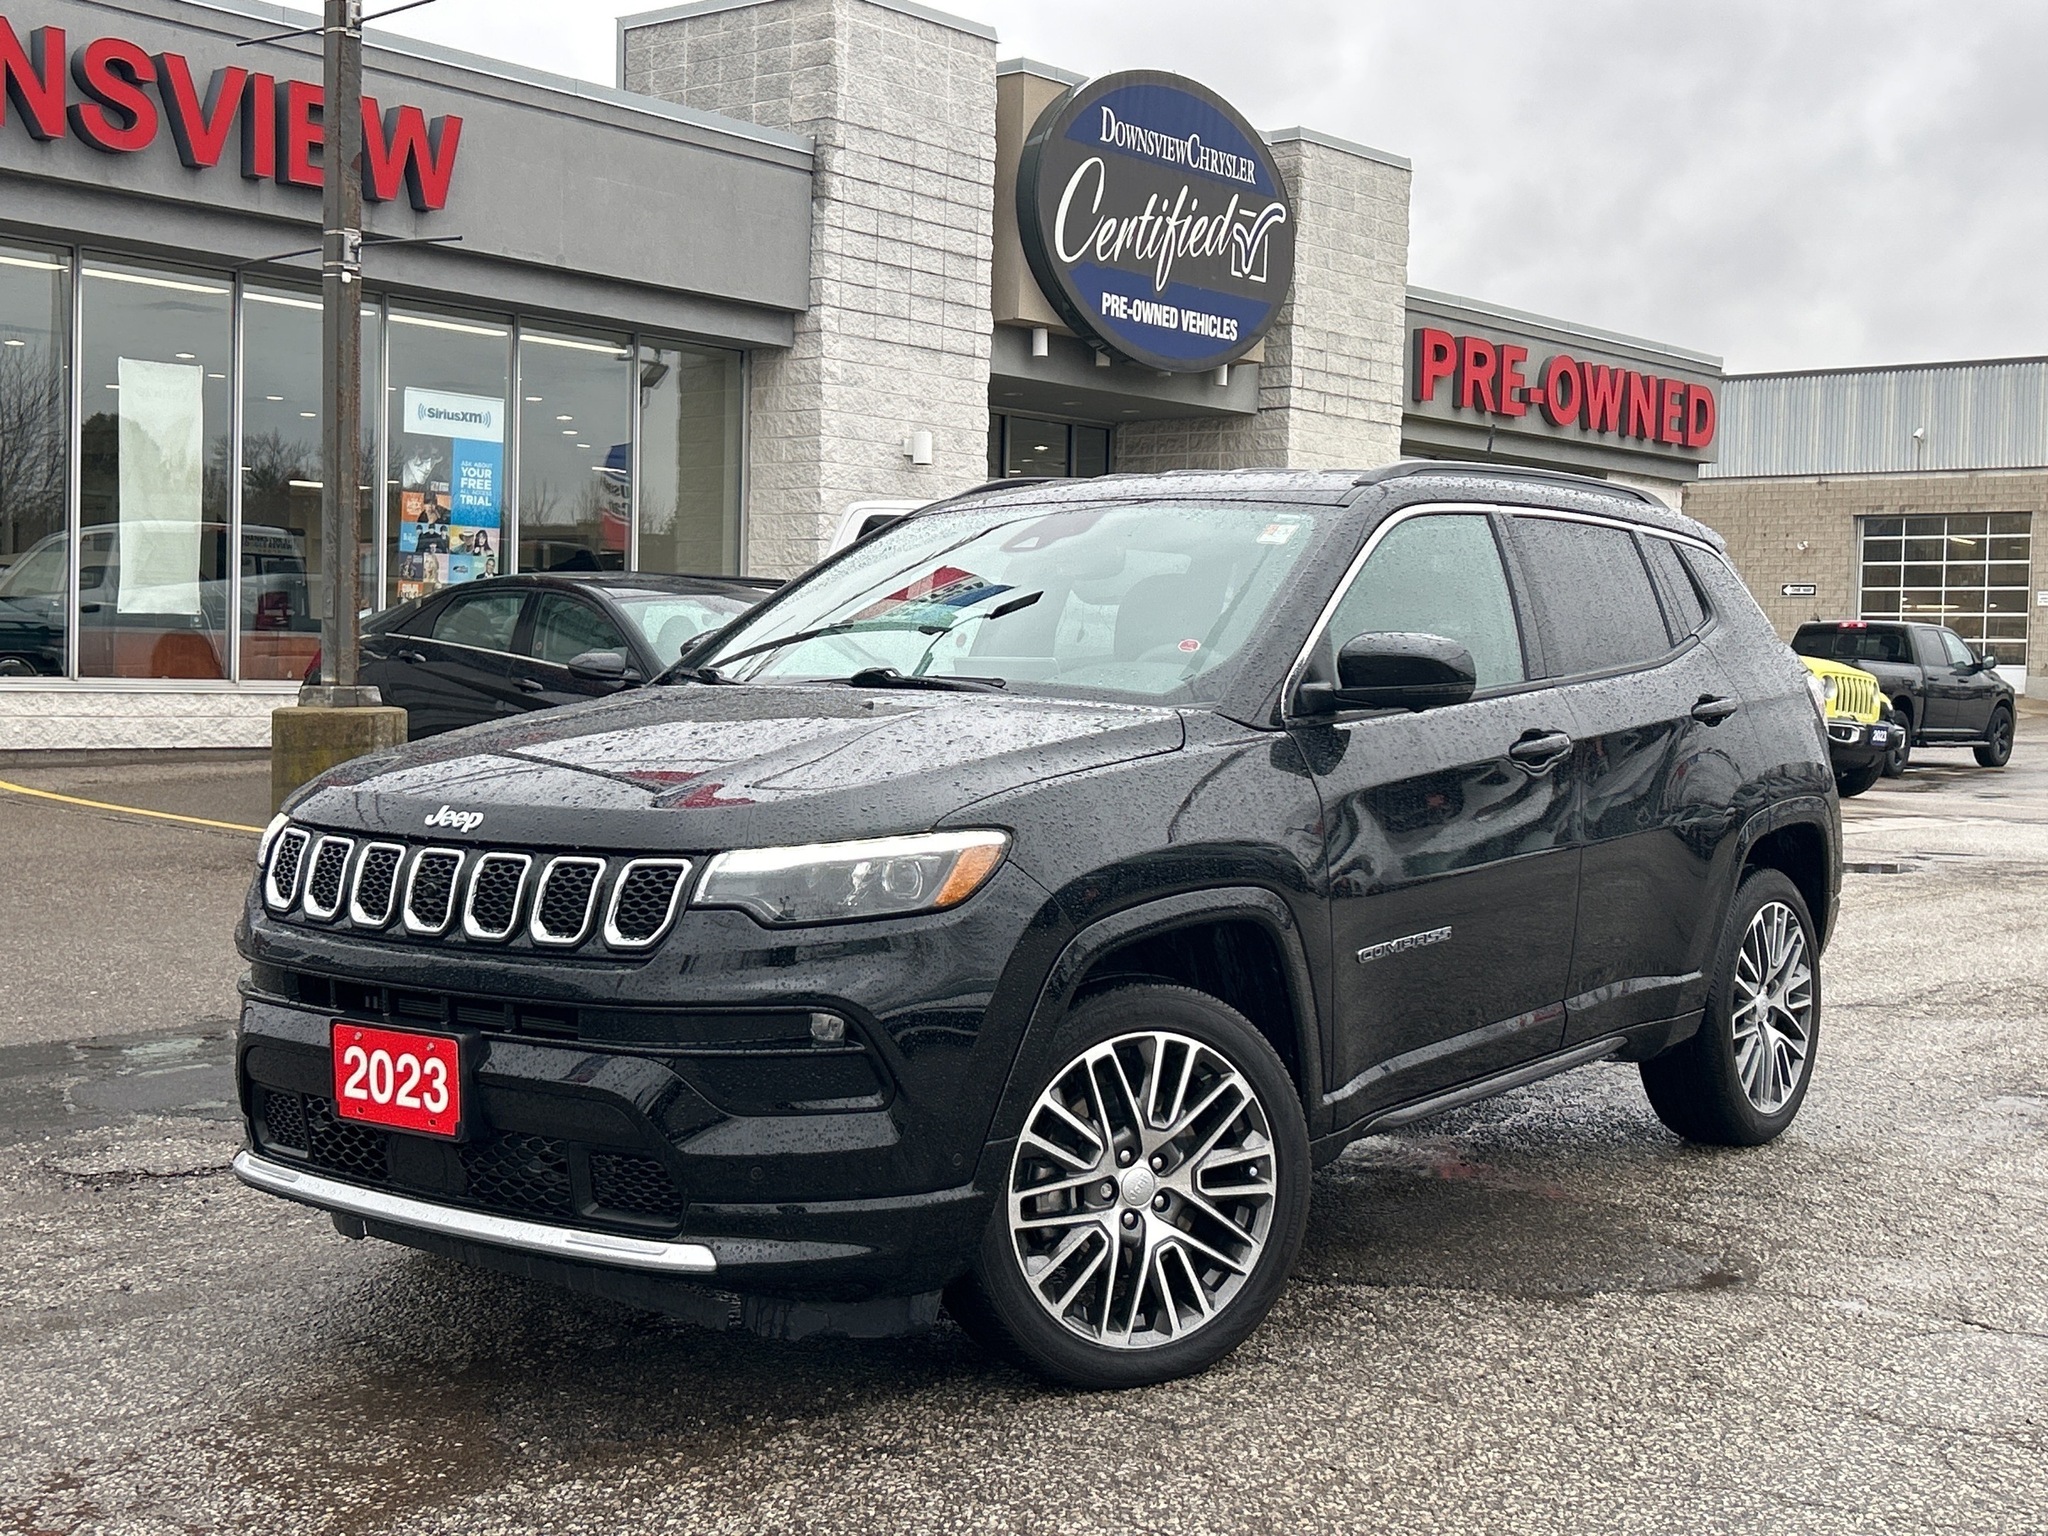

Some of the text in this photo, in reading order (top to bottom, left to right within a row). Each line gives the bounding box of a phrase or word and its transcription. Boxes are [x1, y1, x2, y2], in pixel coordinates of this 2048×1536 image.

[1054, 157, 1239, 291] Certified
[1101, 291, 1238, 341] PRE-OWNED VEHICLES
[1413, 327, 1716, 447] PRE-OWNED
[461, 467, 492, 479] YOUR
[461, 477, 492, 490] FREE
[460, 494, 492, 507] TRIAL
[424, 804, 484, 833] Jeep
[1357, 926, 1452, 963] COMPASS
[344, 1045, 449, 1114] 2023
